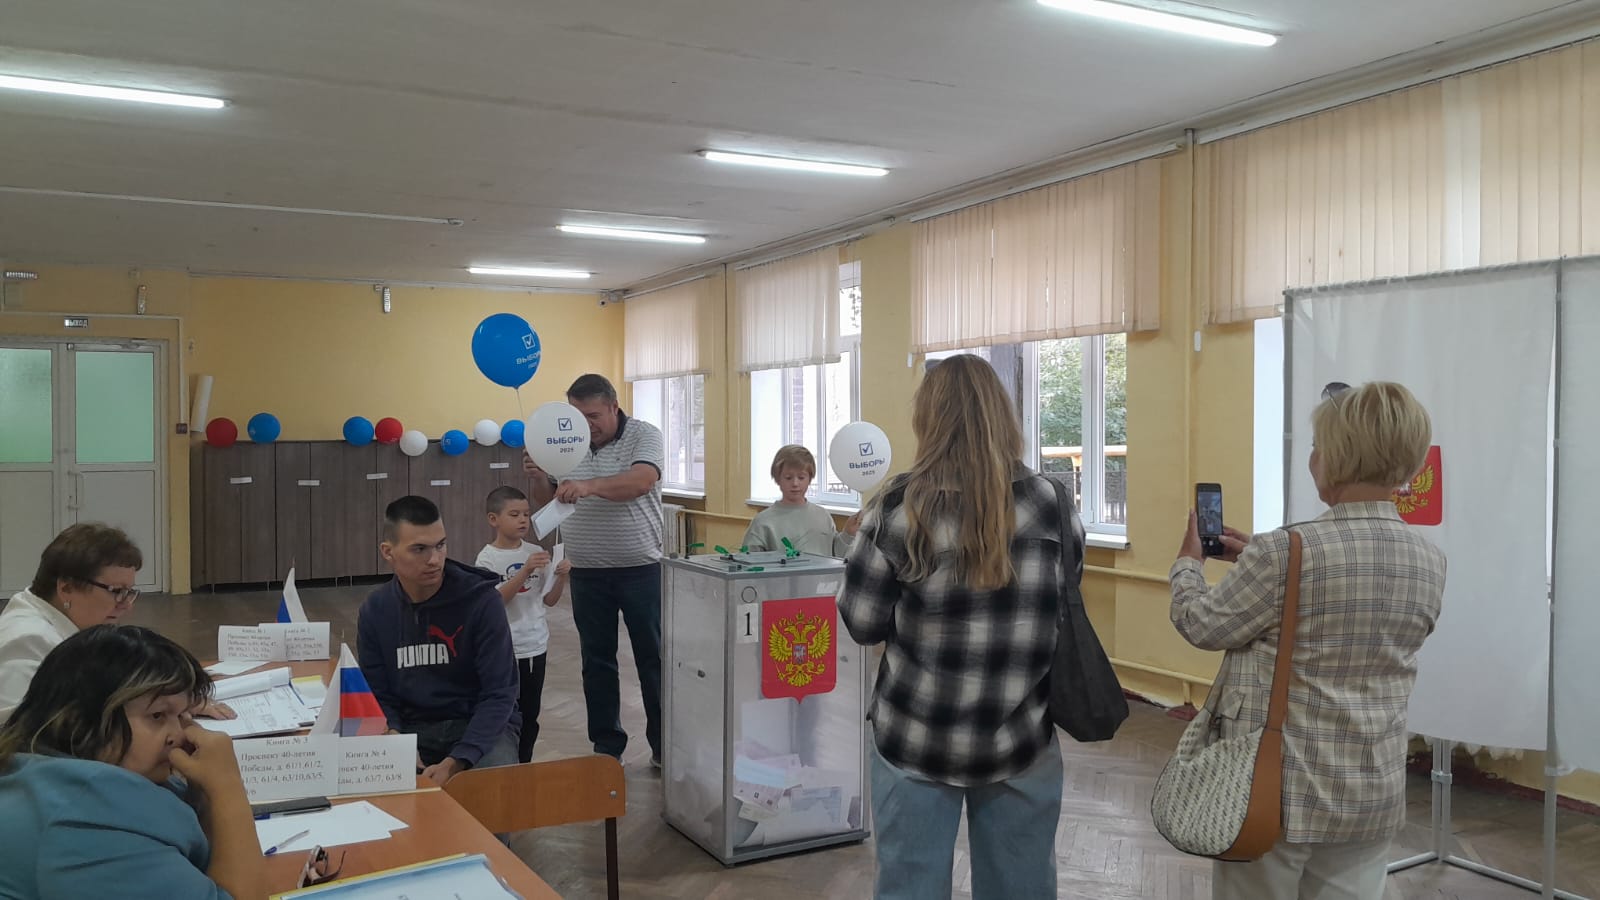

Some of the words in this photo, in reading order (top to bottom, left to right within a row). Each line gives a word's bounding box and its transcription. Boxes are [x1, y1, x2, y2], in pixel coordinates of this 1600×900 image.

[516, 351, 541, 365] ВЫБОР
[546, 436, 585, 445] ВЫБОРЫ
[849, 458, 886, 469] ВЫБОРЫ
[743, 611, 753, 637] 1
[397, 643, 450, 669] PUMA
[266, 738, 290, 746] Книга
[292, 737, 300, 745] №
[241, 753, 278, 761] Проспект
[345, 751, 369, 759] Книга
[371, 749, 380, 757] №
[360, 763, 394, 771] 40-летия
